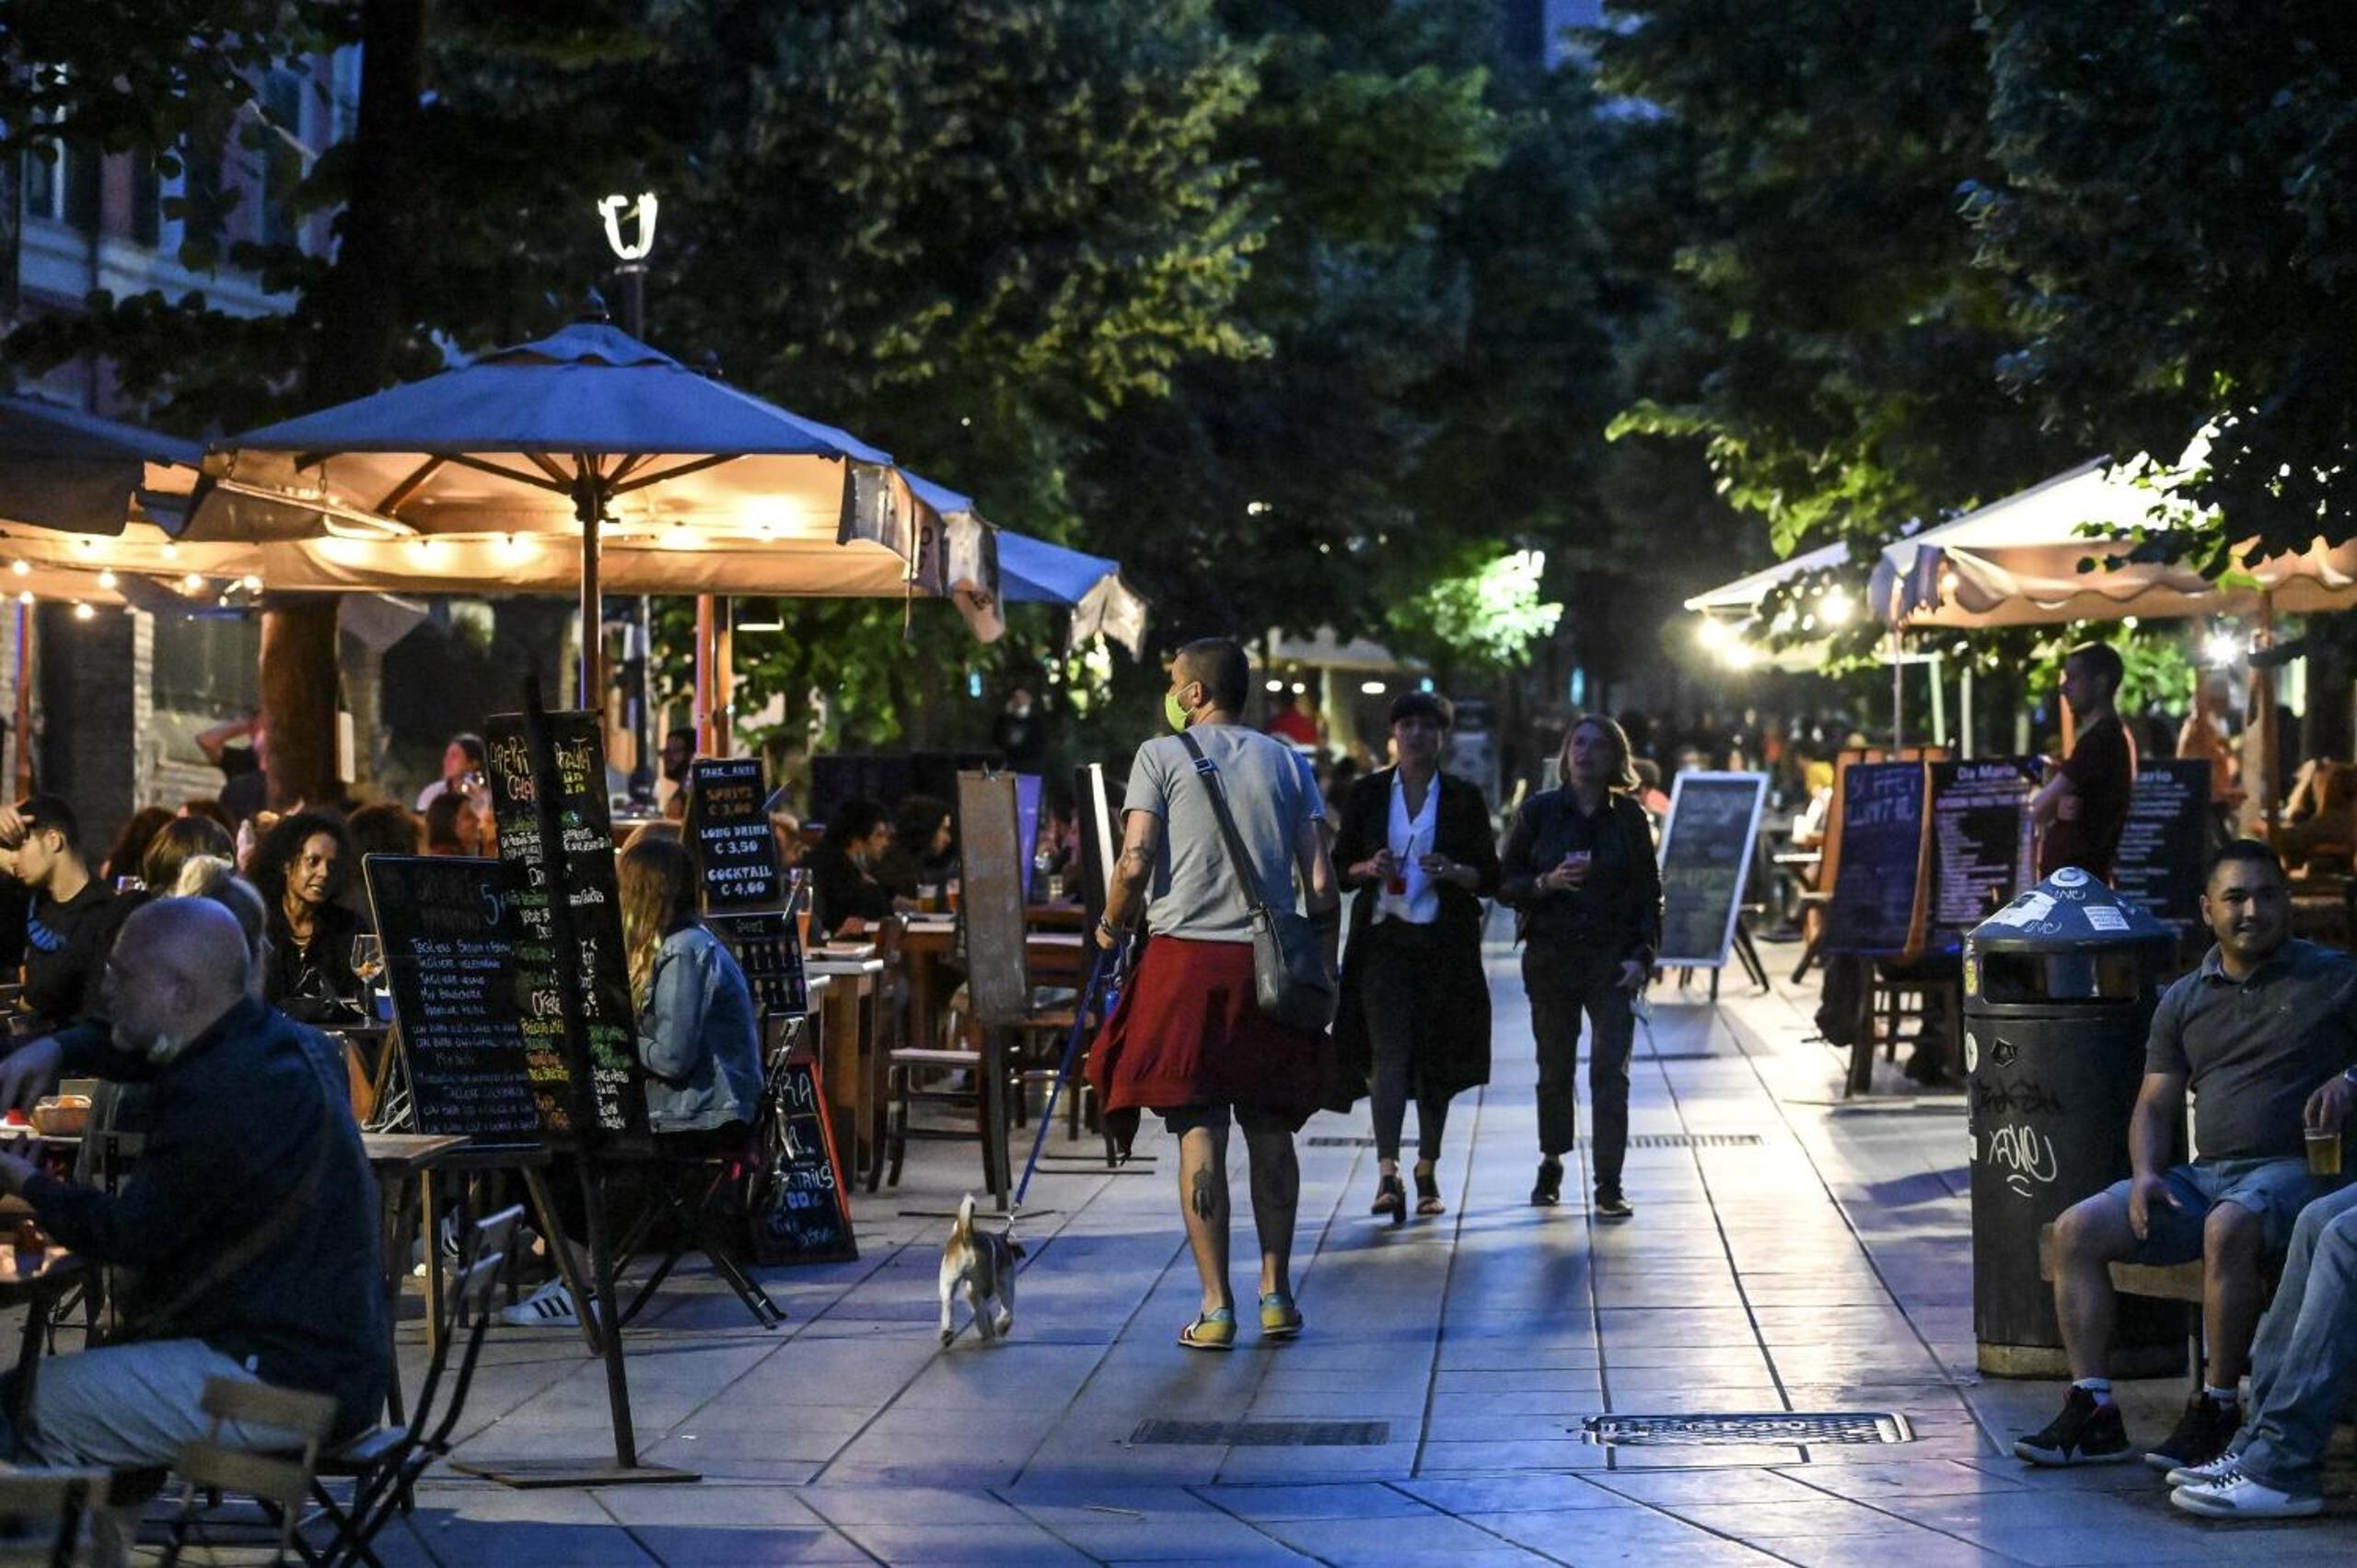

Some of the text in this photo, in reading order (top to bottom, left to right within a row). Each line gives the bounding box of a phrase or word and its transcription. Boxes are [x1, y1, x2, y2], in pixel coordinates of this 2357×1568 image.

[1980, 764, 2018, 779] Mario
[701, 824, 770, 839] LONG DRINK
[708, 865, 772, 881] COCKTAIL
